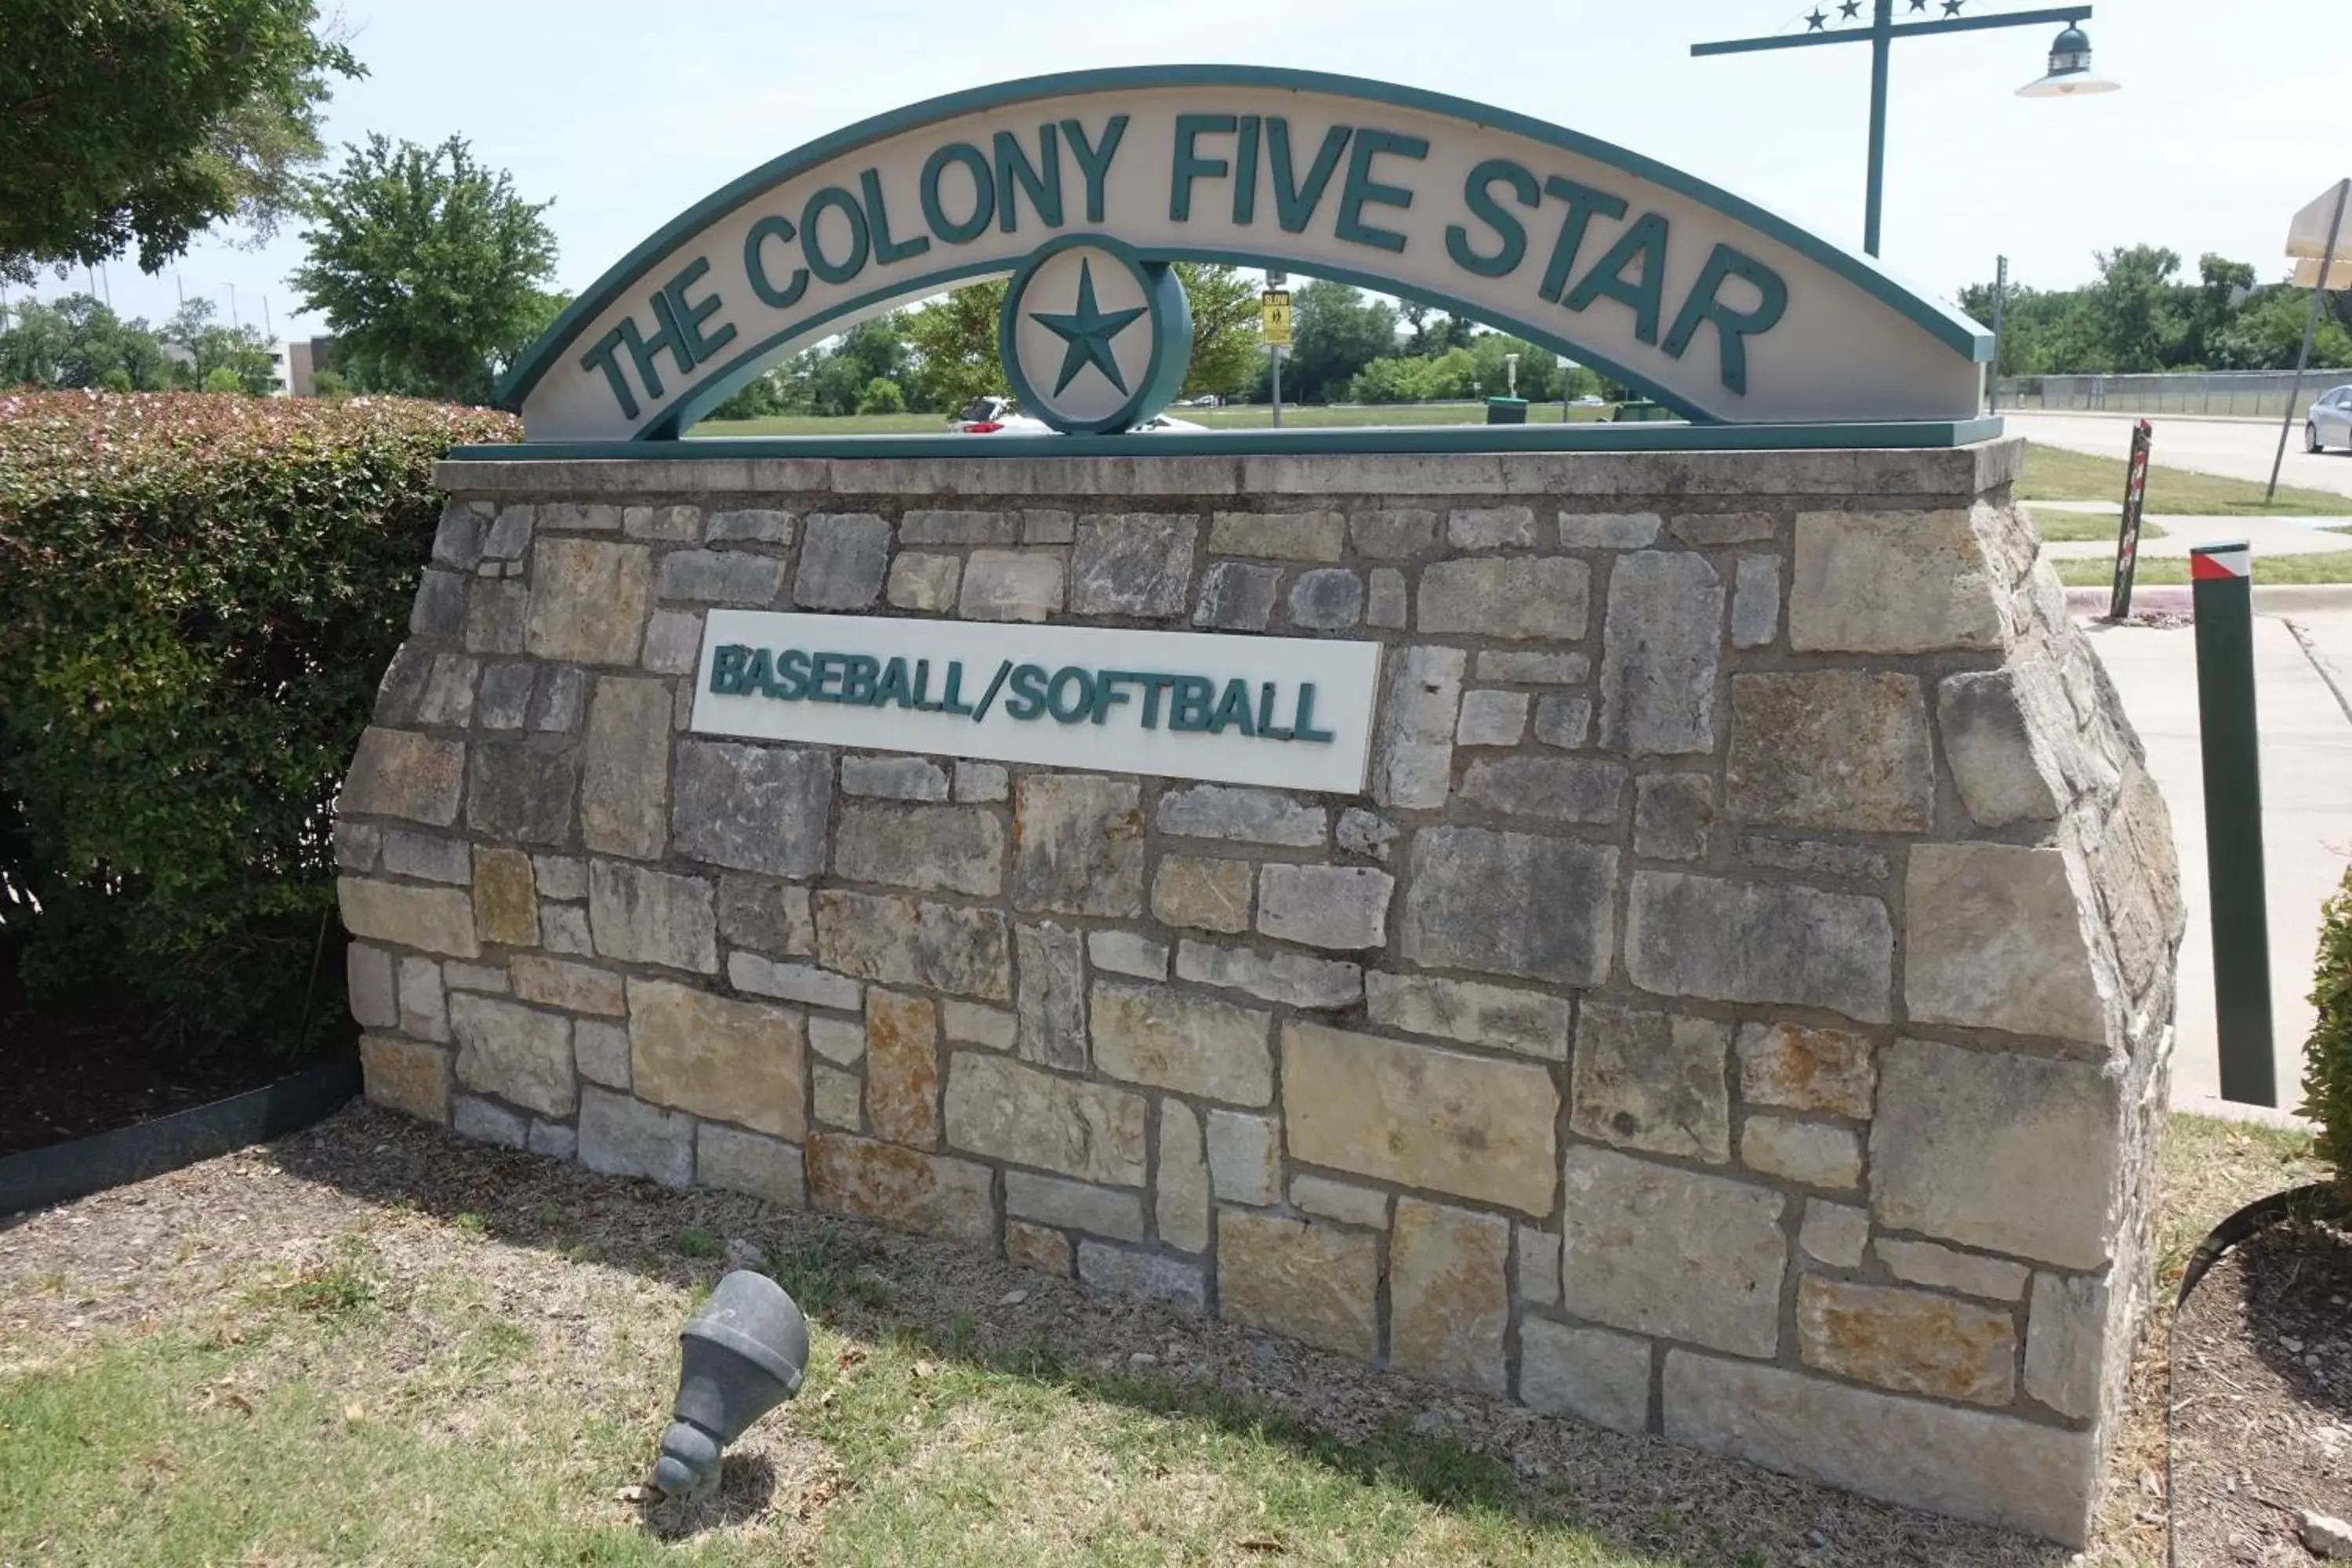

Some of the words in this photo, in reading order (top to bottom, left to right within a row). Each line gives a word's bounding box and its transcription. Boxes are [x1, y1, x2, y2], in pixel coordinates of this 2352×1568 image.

[579, 256, 738, 420] THE
[744, 114, 1130, 309] COLONY
[1169, 114, 1429, 253] FIVE
[1445, 159, 1788, 397] STAR
[1265, 293, 1288, 305] SLOW
[710, 644, 1334, 743] BASEBALL/SOFTBALL
